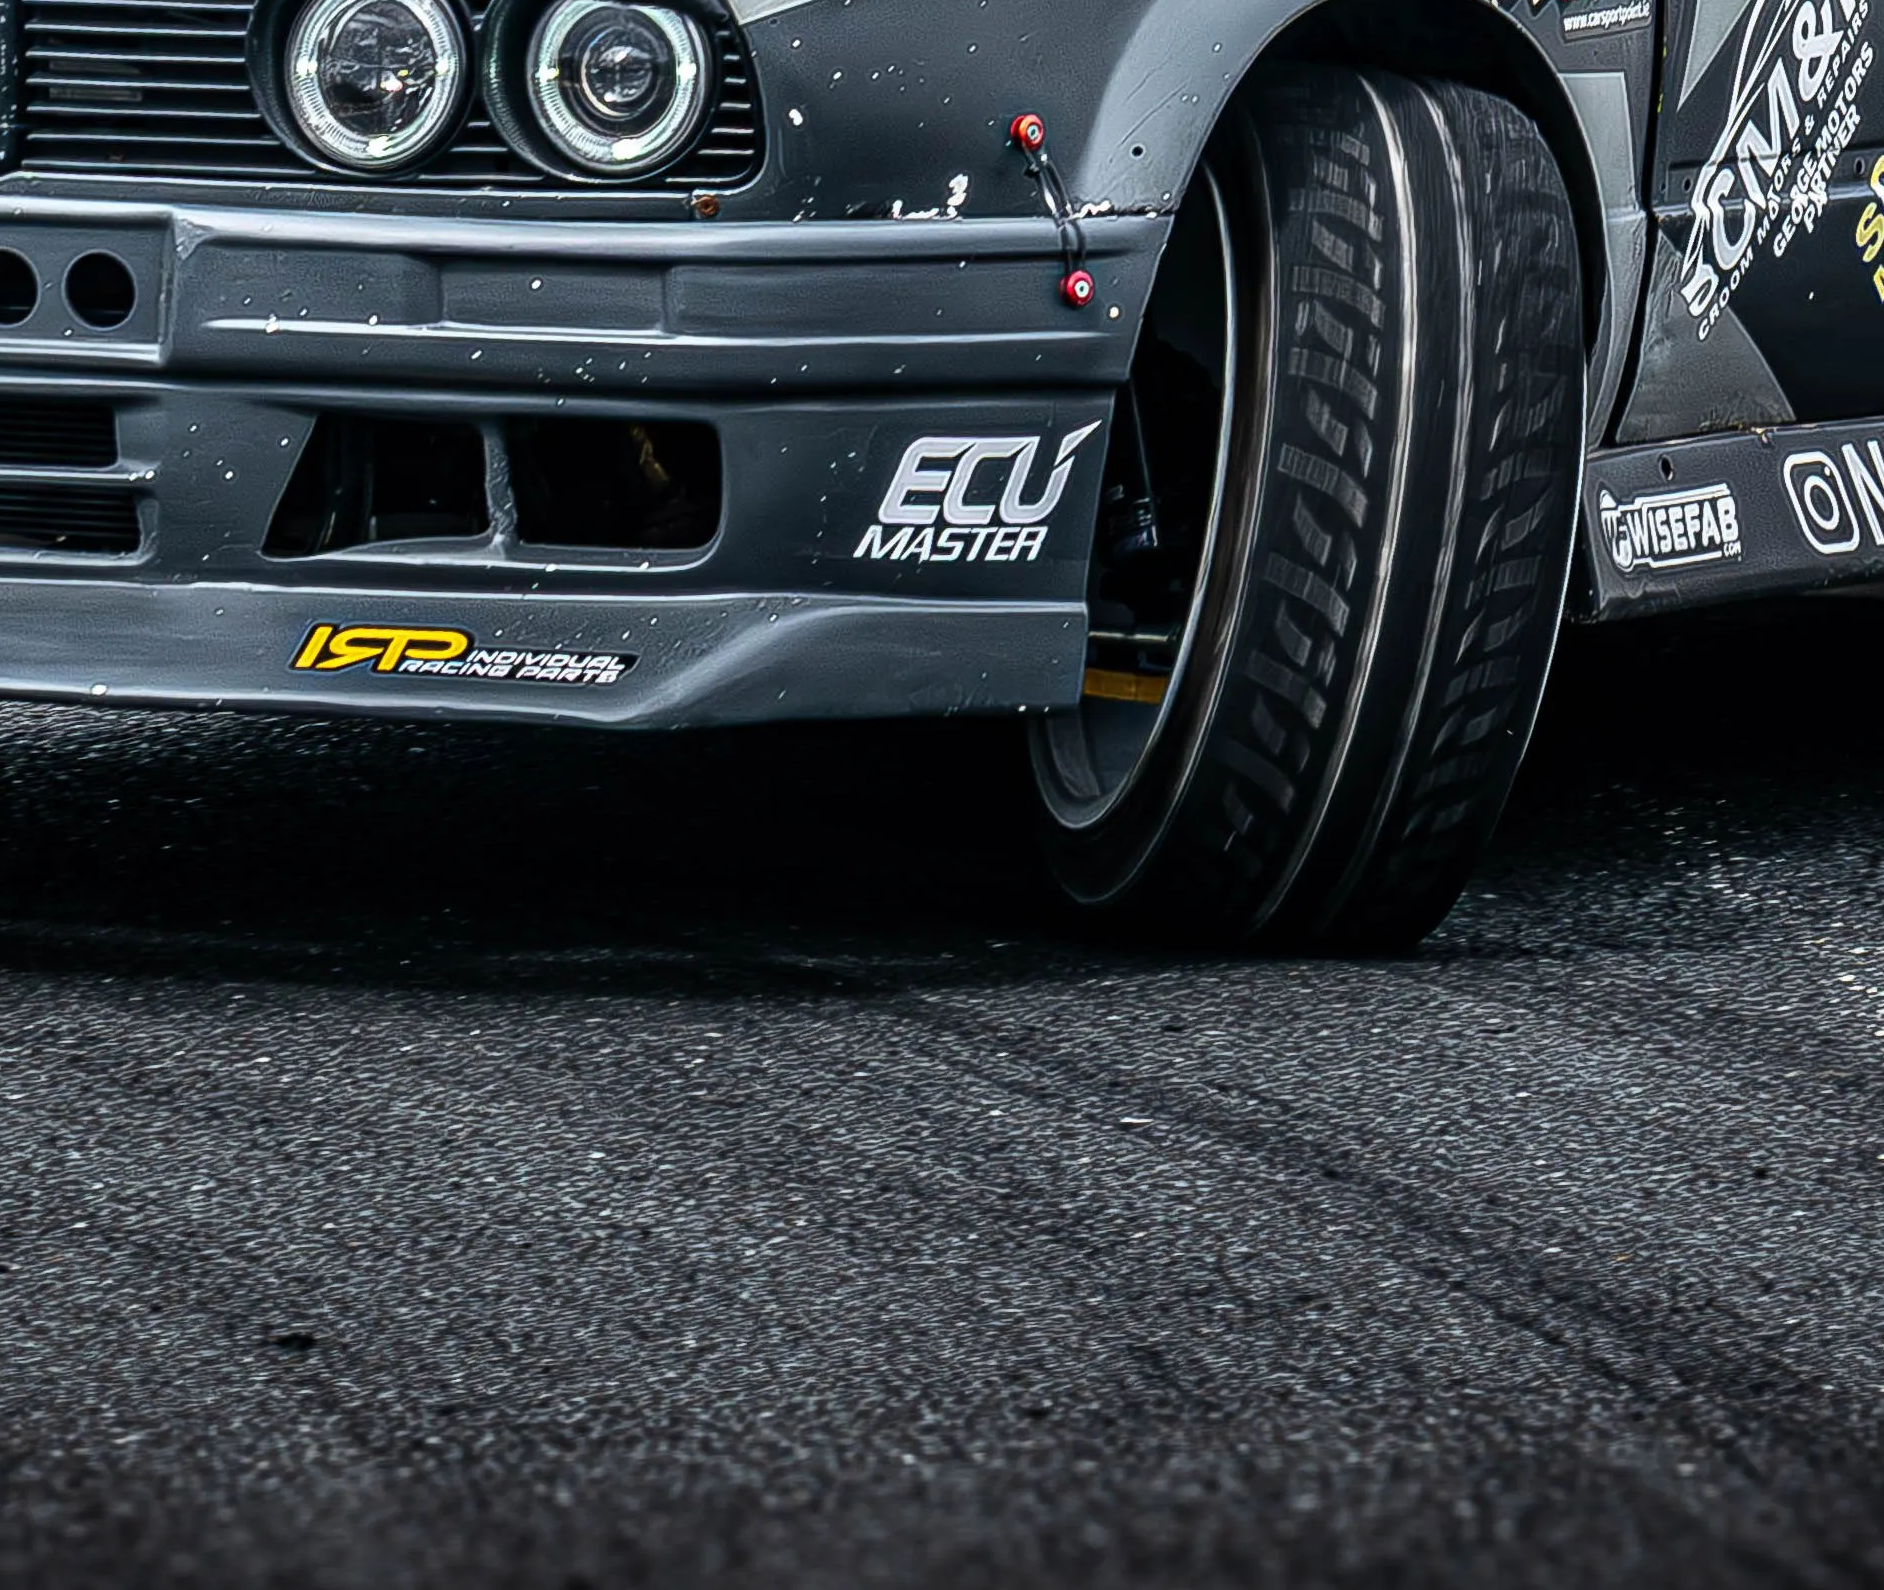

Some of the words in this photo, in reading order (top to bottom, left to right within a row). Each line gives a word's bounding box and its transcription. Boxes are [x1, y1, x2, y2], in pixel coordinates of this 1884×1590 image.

[1815, 41, 1874, 154] MOTORS
[1698, 248, 1754, 341] CROOM
[1756, 137, 1802, 244] MOTORS
[1804, 114, 1815, 135] &
[877, 419, 1103, 525] ECU
[853, 524, 1049, 562] MASTER
[1626, 495, 1739, 557] WISEFAB
[399, 659, 509, 678] RACING
[515, 665, 620, 684] PARTS
[466, 649, 625, 671] INDIVIDUAL
